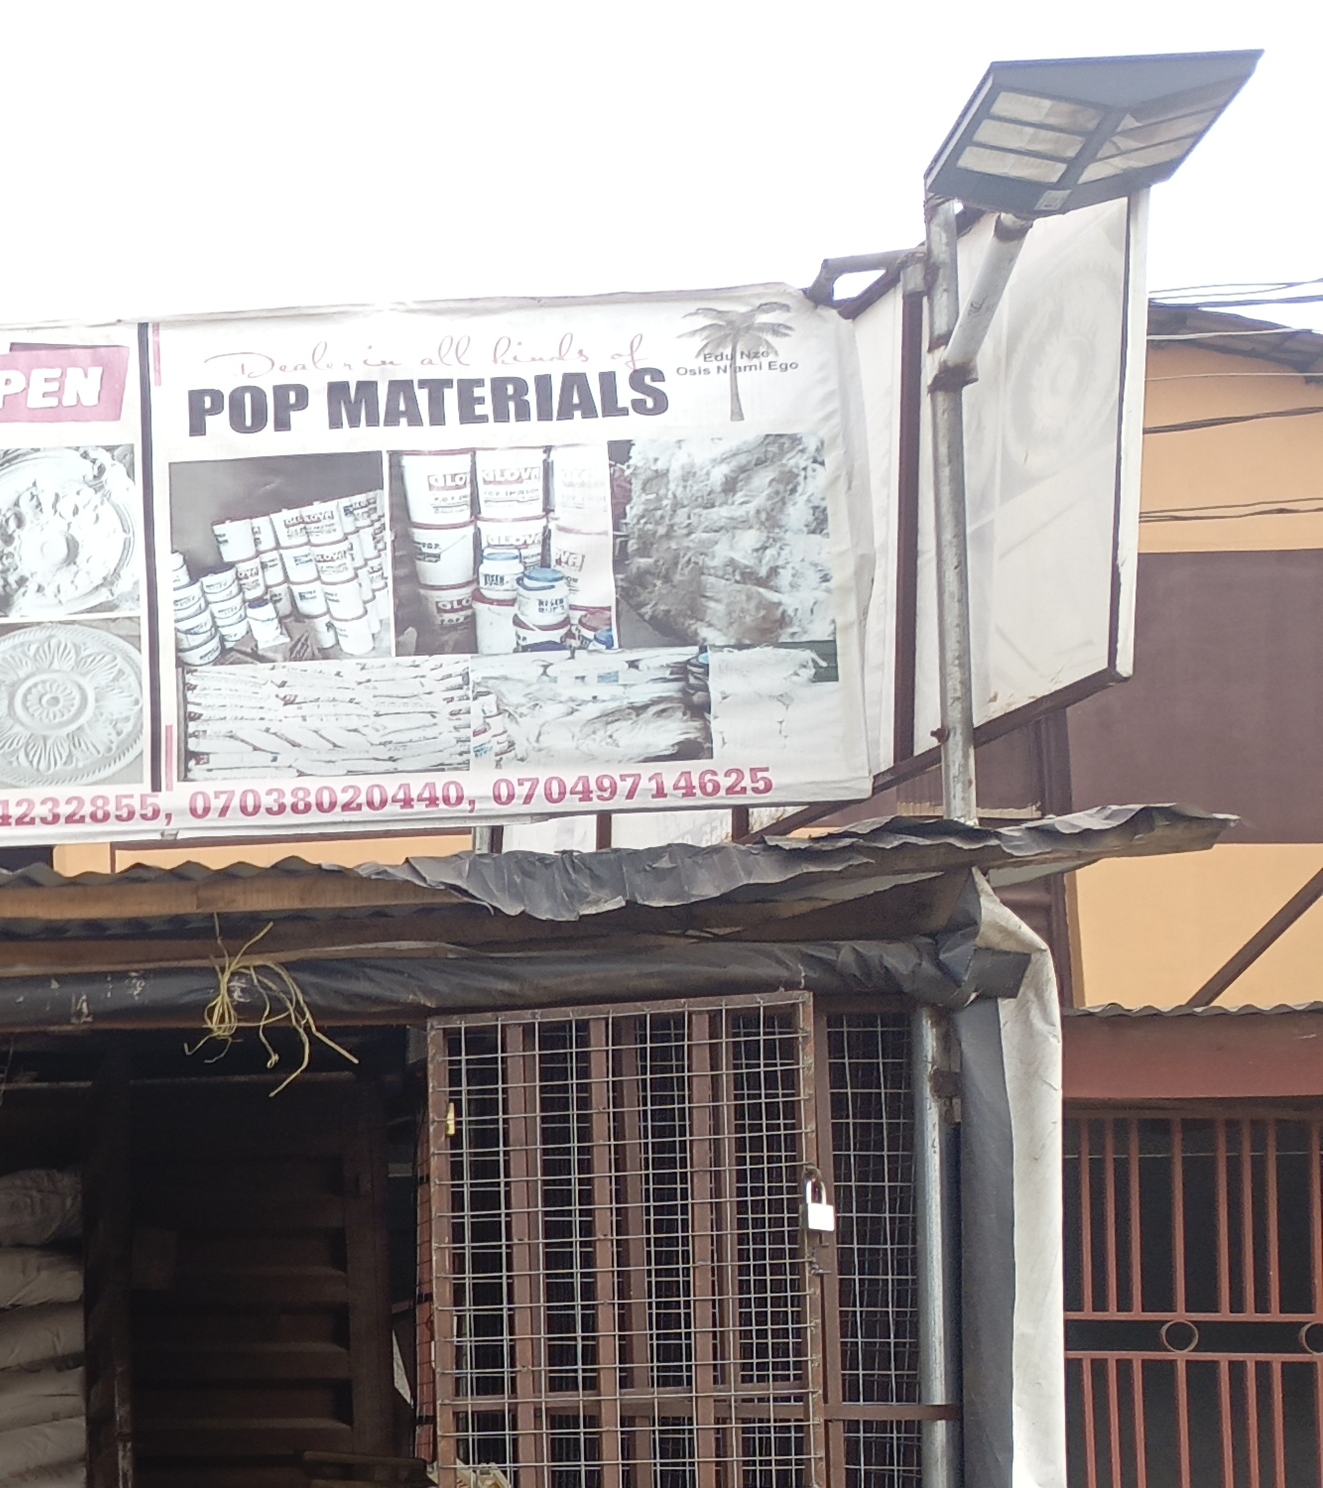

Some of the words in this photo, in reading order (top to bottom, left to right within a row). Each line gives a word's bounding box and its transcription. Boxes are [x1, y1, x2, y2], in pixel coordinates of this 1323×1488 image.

[363, 345, 402, 367] in
[421, 335, 471, 367] all
[493, 332, 589, 366] kinds
[612, 333, 650, 370] of
[676, 366, 711, 376] Osis
[768, 361, 799, 373] Ego
[188, 383, 309, 437] POP
[327, 367, 669, 429] MATERIALS
[189, 781, 476, 820] 07038020440,
[493, 767, 773, 806] 07049714625
